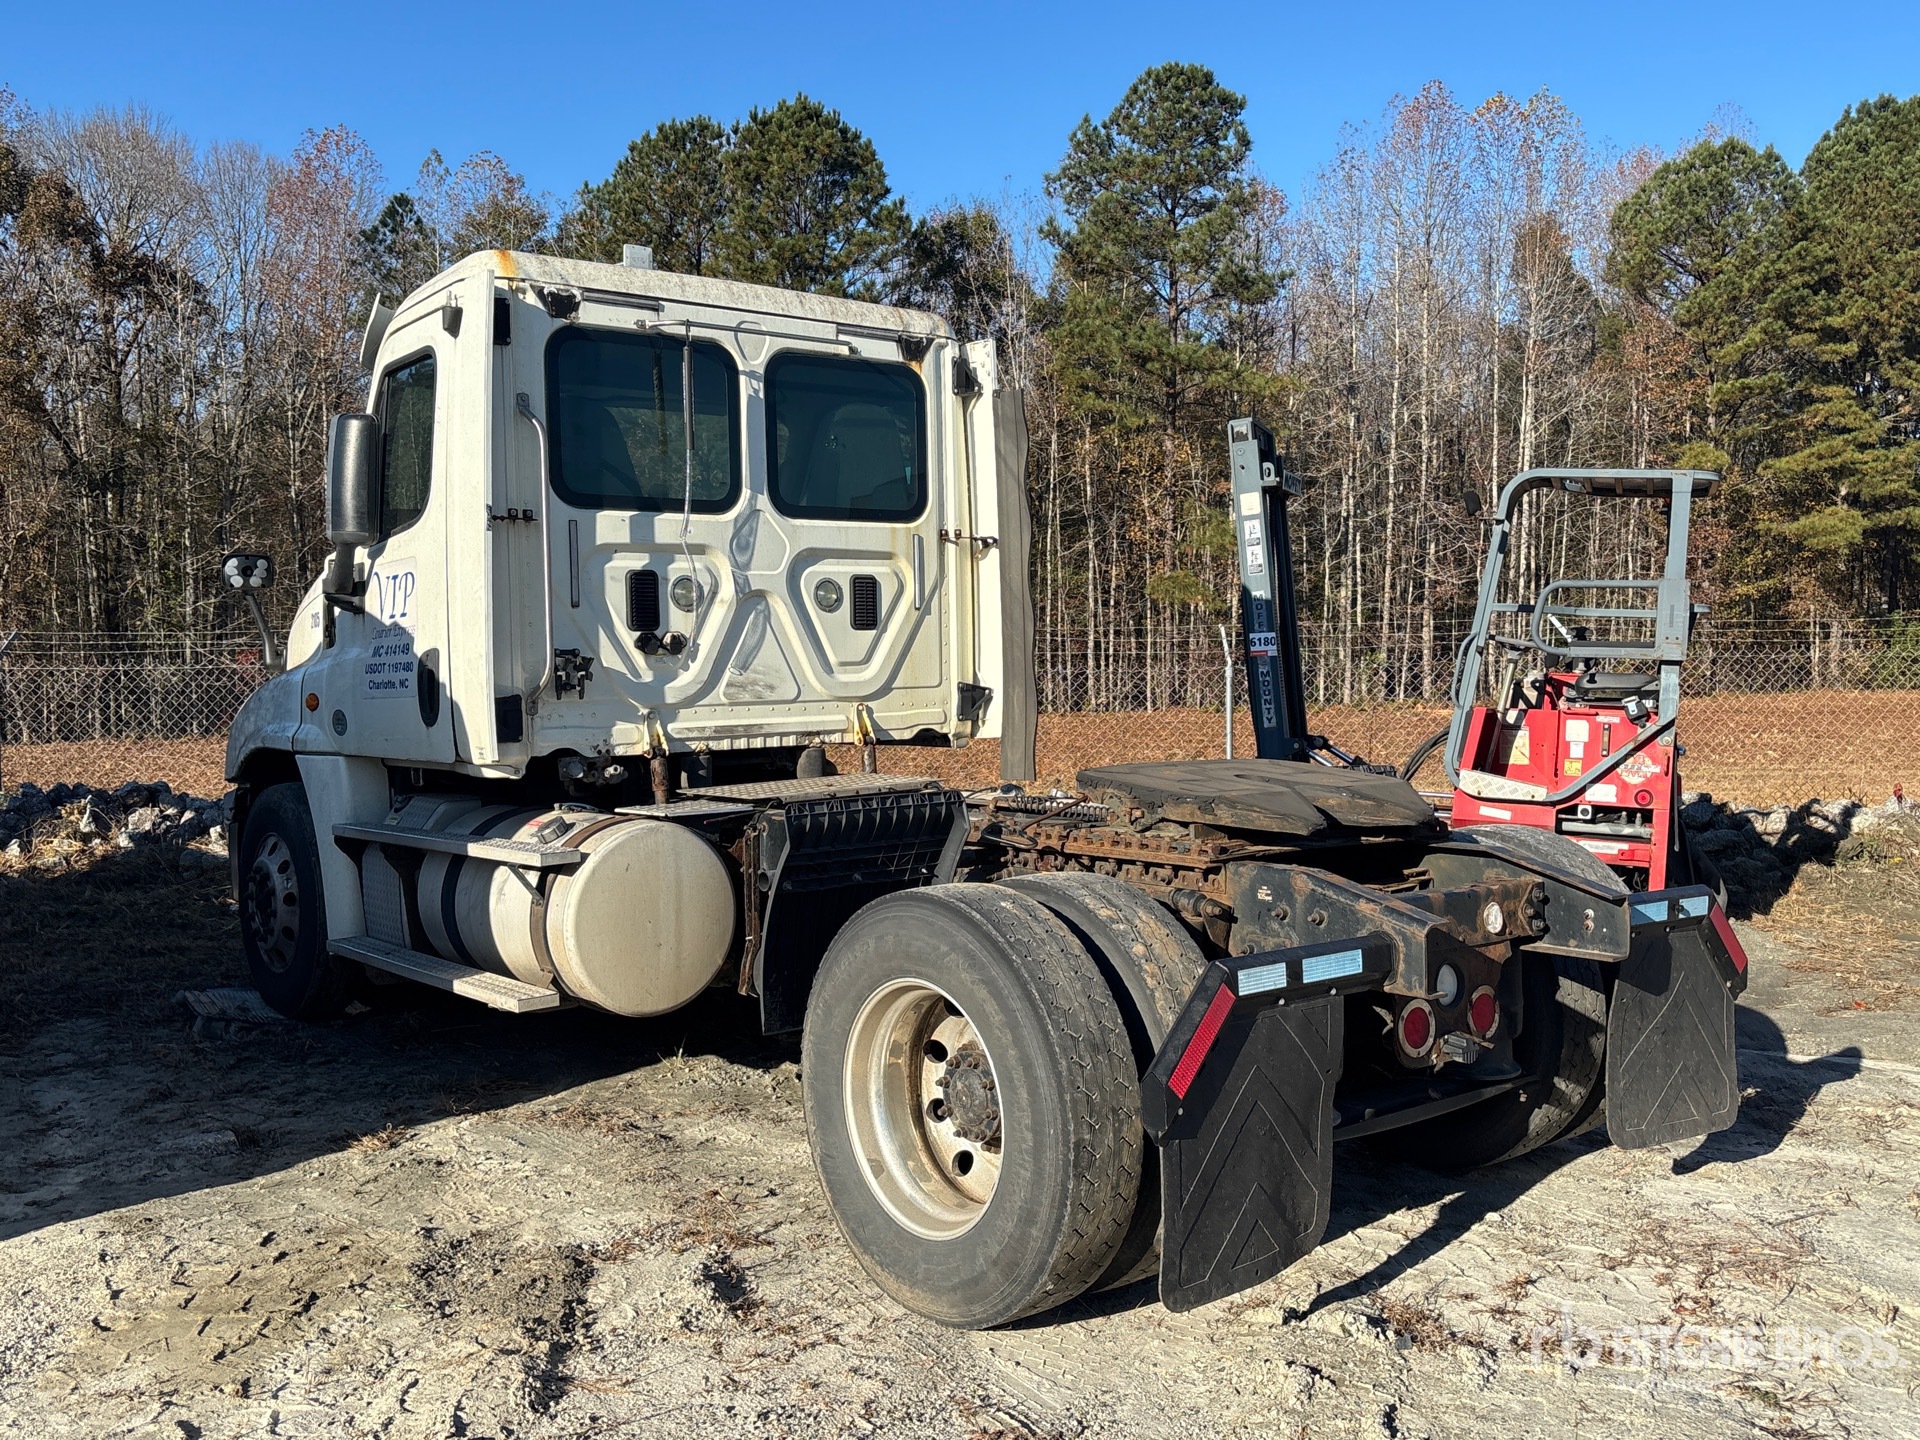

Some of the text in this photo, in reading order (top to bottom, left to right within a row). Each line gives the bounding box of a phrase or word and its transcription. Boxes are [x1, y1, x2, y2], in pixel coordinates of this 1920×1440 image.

[372, 571, 415, 621] VIP
[1250, 636, 1276, 647] 6180
[371, 642, 410, 658] MC 414149
[365, 661, 414, 674] USDOT 1197480
[368, 678, 409, 691] Charlotte, NC
[1260, 670, 1273, 724] MOUNTY
